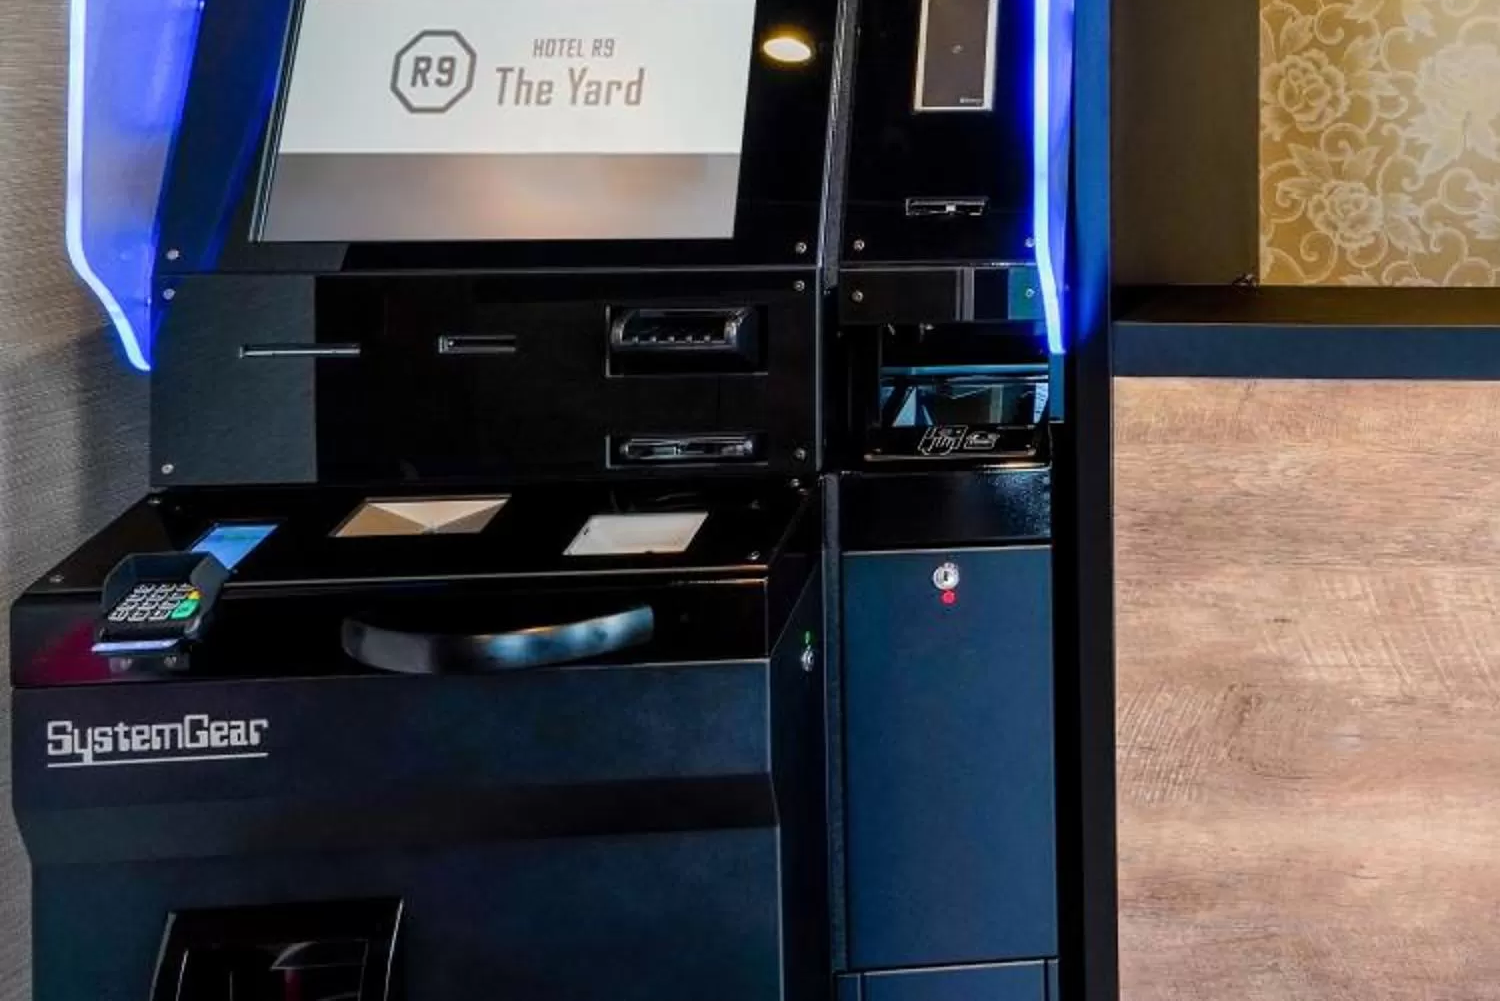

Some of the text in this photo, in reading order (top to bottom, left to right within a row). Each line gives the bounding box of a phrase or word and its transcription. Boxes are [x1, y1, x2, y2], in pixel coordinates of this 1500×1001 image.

[532, 38, 616, 58] HOTEL R9
[410, 55, 457, 88] R9
[495, 66, 645, 106] The Yard
[47, 714, 269, 765] SystemGear
